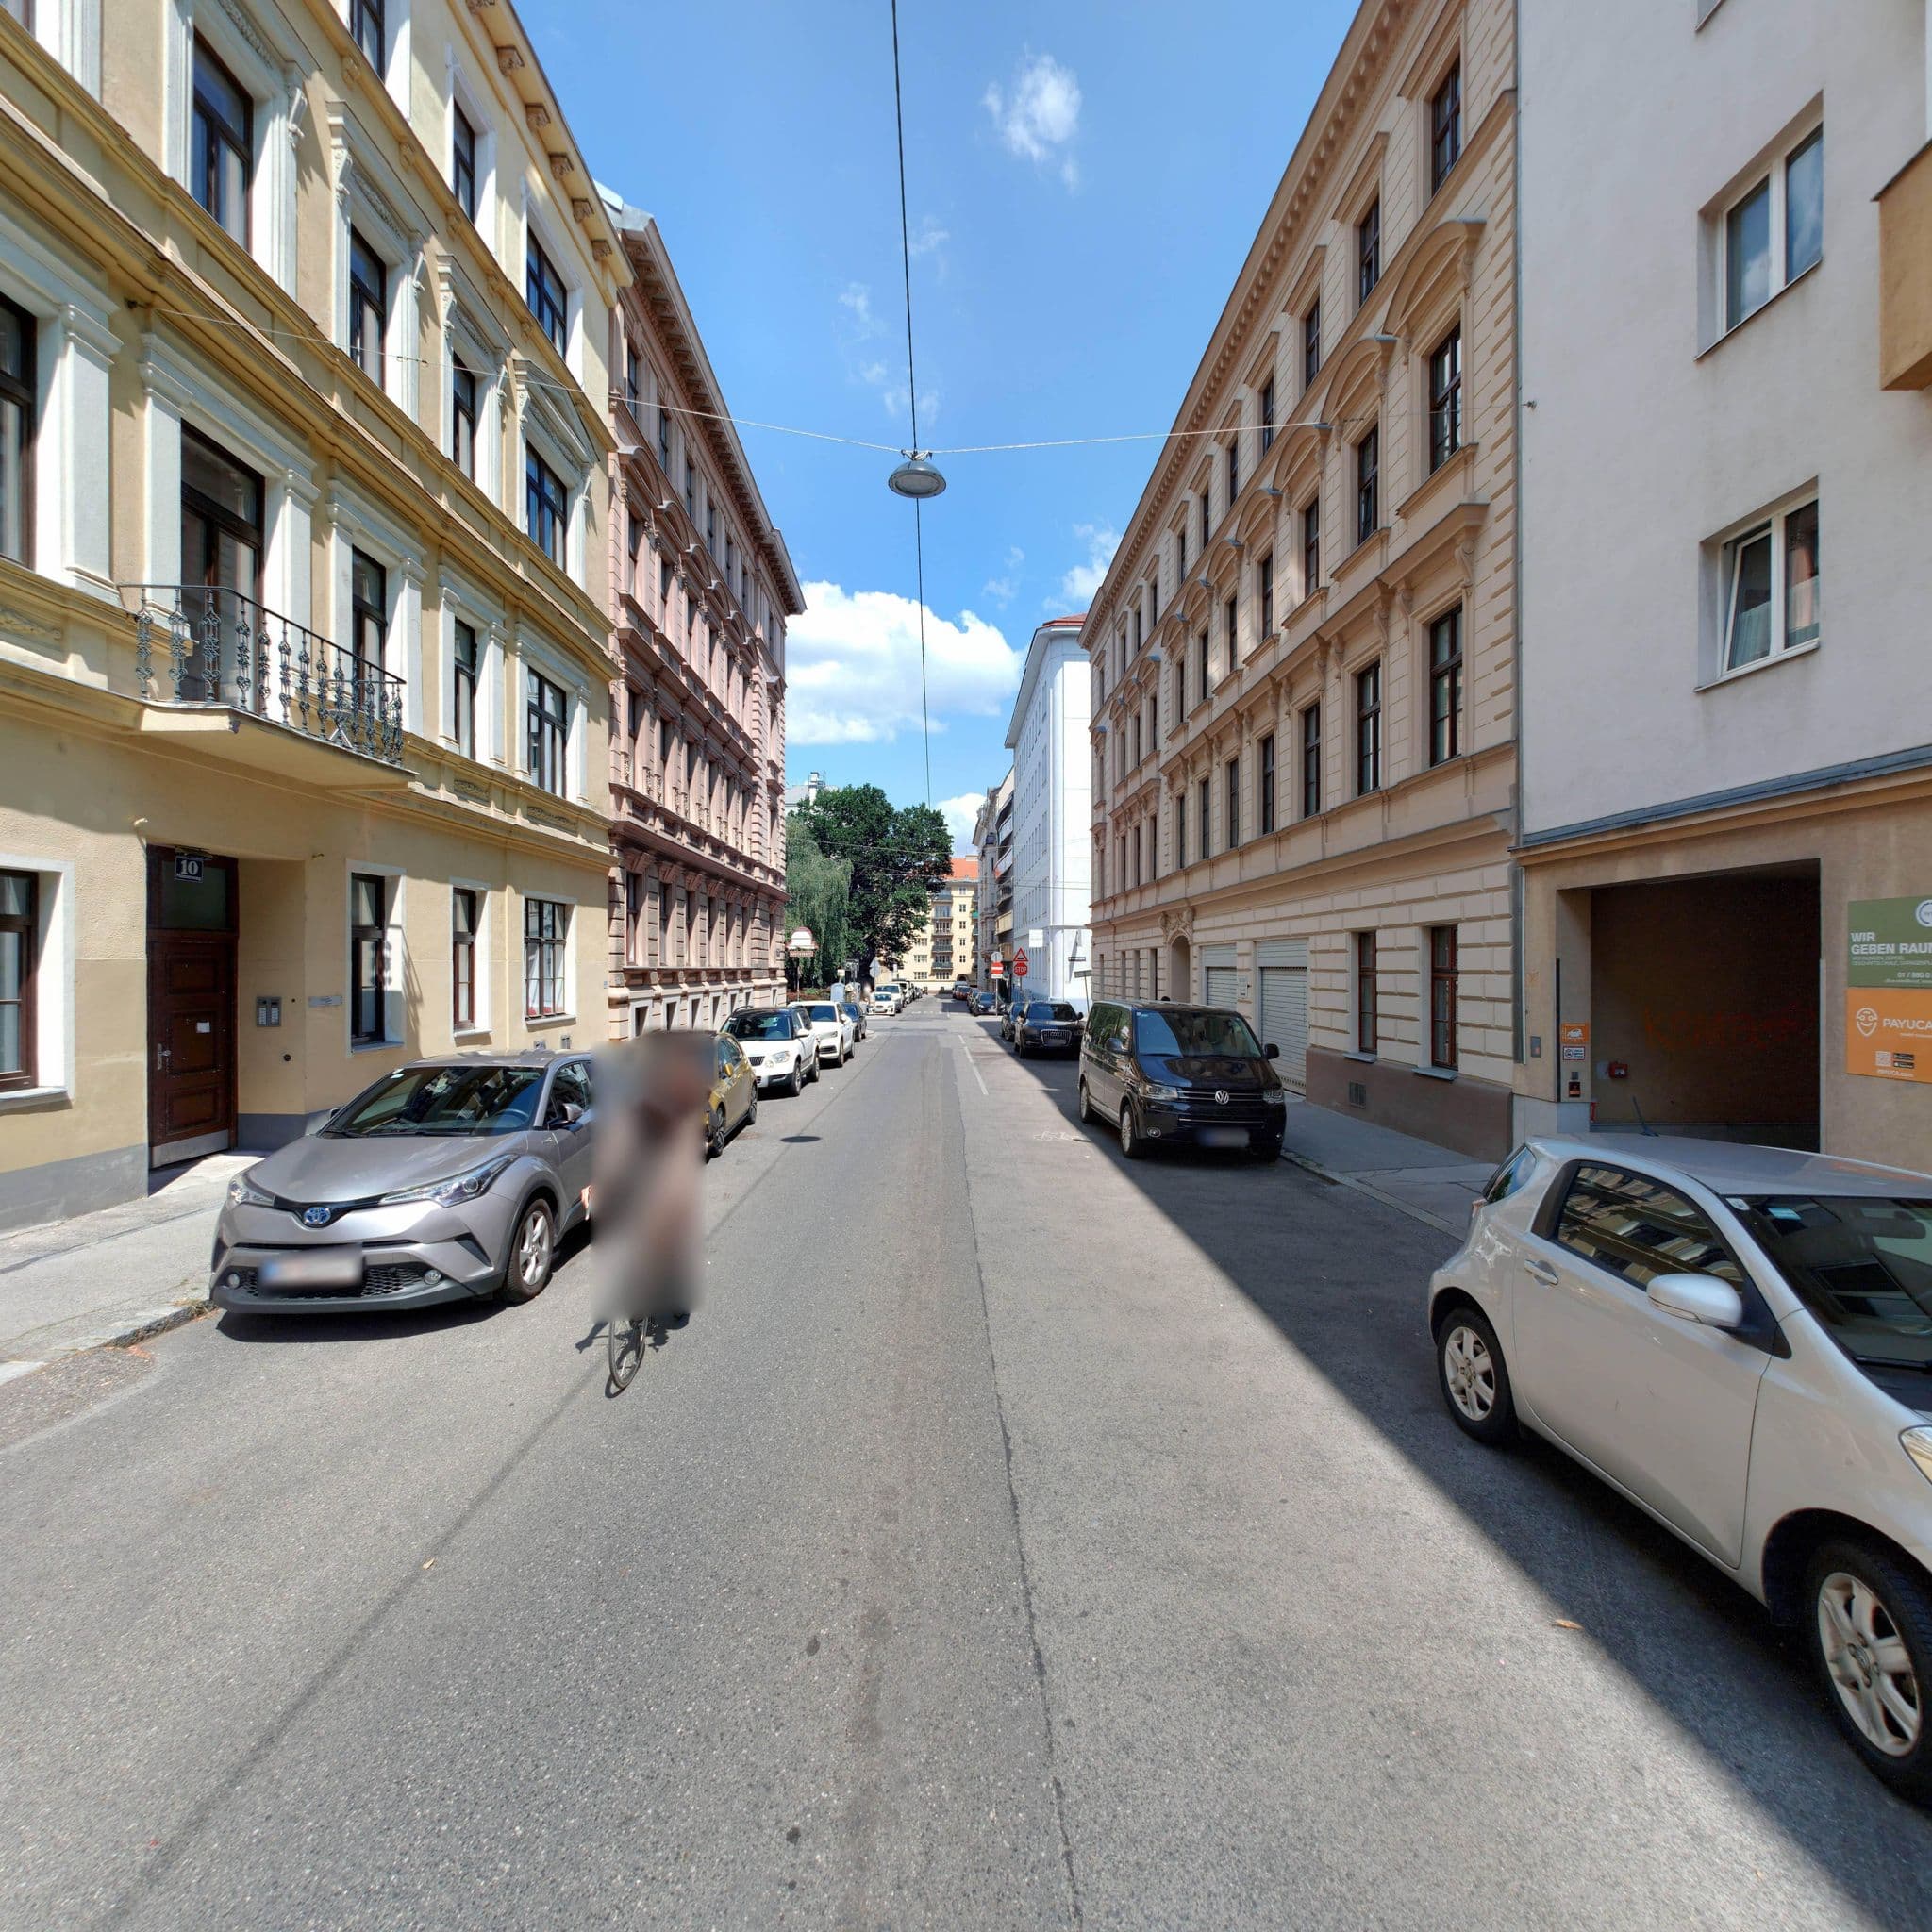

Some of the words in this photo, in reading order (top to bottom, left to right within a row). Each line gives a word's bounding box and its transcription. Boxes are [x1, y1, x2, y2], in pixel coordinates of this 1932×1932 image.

[180, 859, 199, 875] 10
[1850, 931, 1875, 942] WIR
[1851, 943, 1895, 955] GEBEN
[1882, 1018, 1932, 1031] PAYUCA
